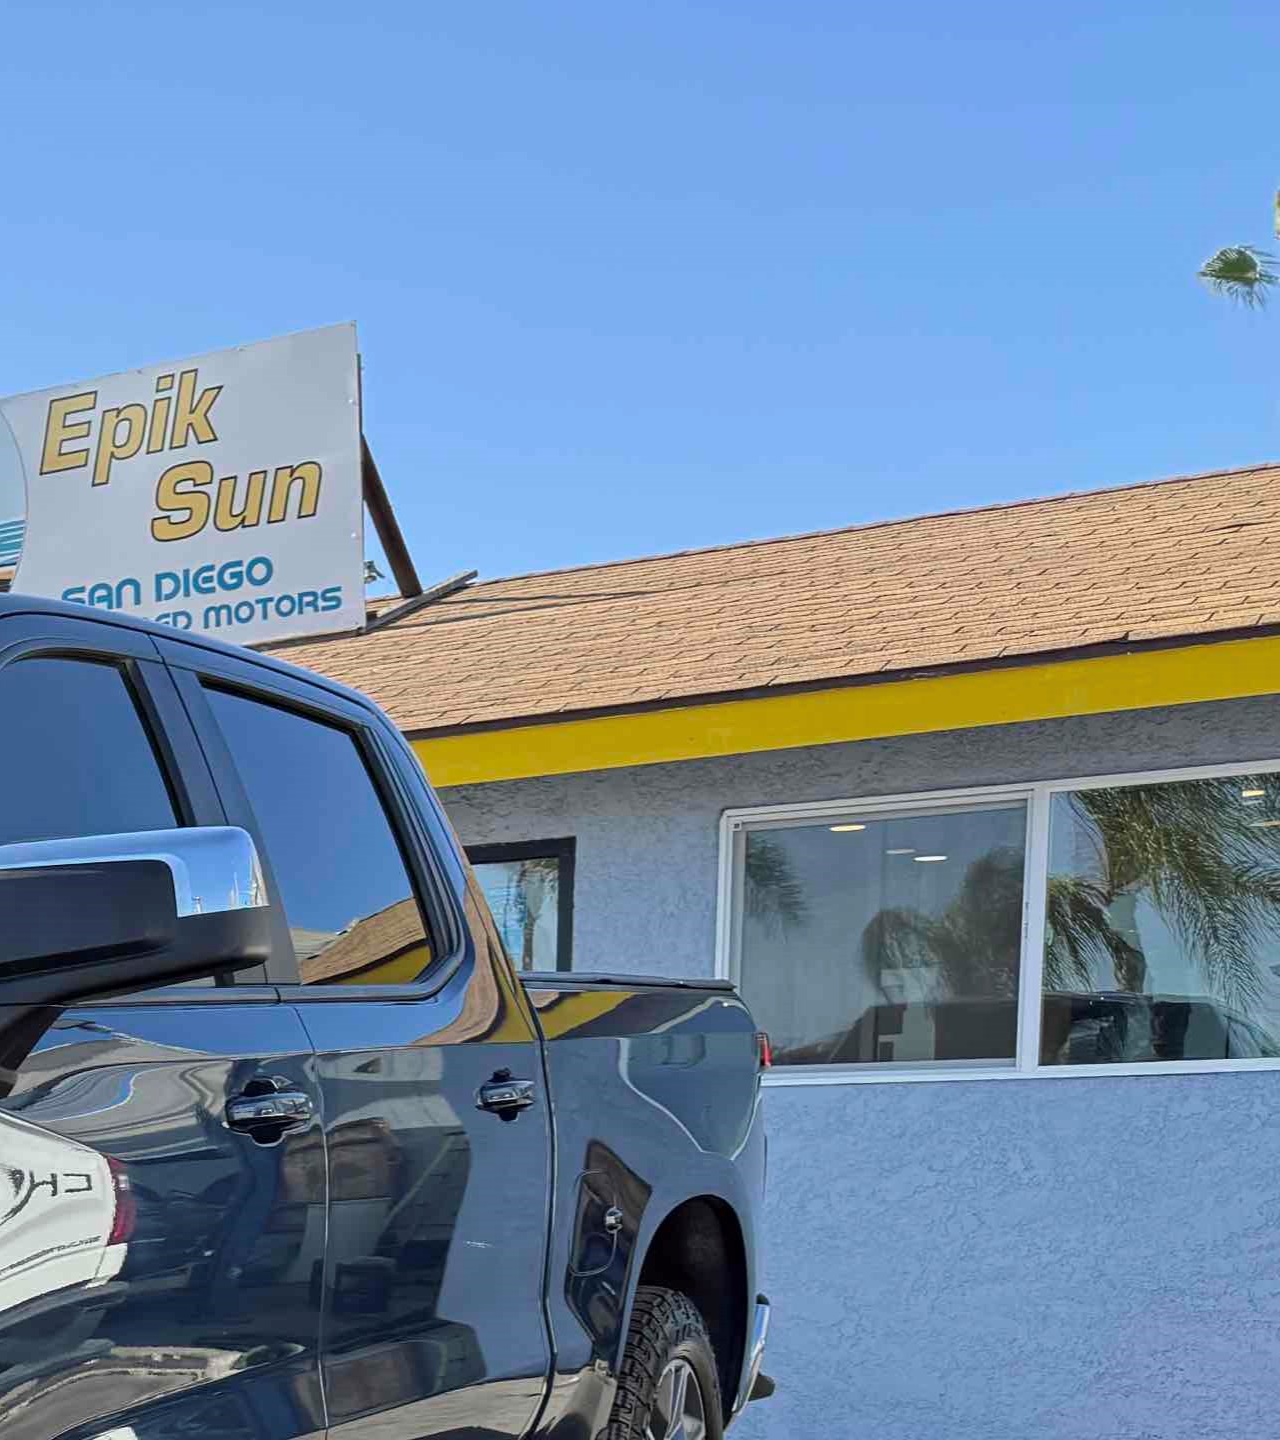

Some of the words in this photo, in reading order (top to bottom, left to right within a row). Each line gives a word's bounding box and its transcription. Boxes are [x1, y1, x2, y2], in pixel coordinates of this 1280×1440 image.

[40, 368, 224, 487] Epik
[151, 460, 323, 542] Sun
[61, 578, 142, 610] SAN
[155, 556, 274, 602] DIEGO
[203, 586, 343, 629] MOTORS
